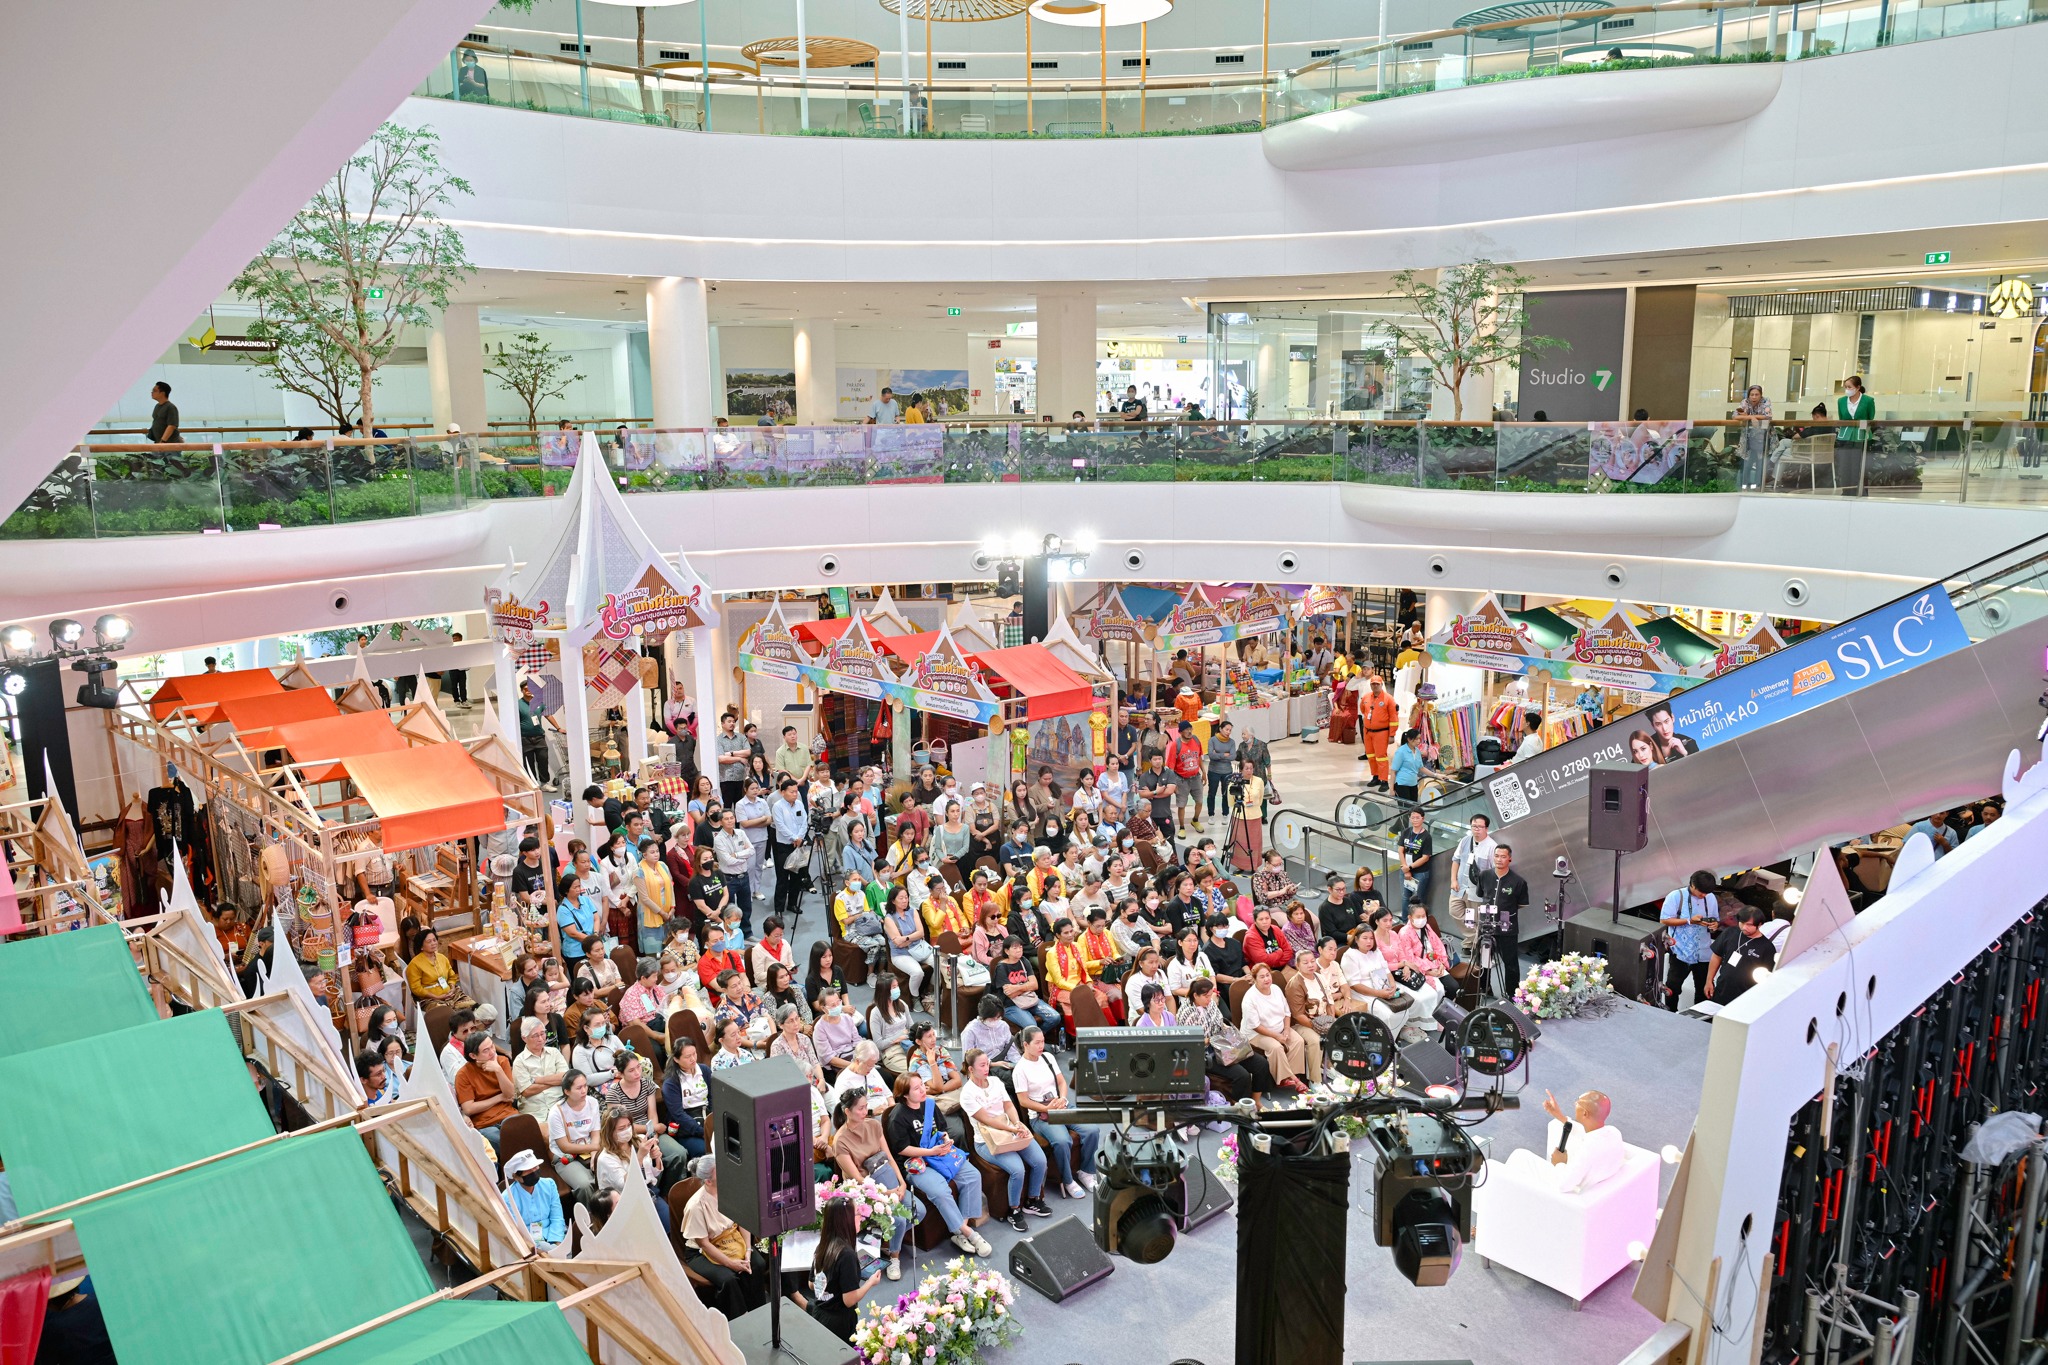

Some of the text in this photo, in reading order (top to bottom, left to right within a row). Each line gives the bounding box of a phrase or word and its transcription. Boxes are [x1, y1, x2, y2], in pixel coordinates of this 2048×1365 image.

[1529, 368, 1613, 392] Studio 7
[617, 588, 649, 600] มหกรรม
[1731, 644, 1759, 652] มหกรรม
[1837, 616, 1933, 680] SLC
[1802, 667, 1819, 677] PLUS
[1758, 678, 1790, 696] Ultherapy
[1764, 687, 1789, 700] PROGRAM
[1679, 700, 1723, 728] หน้าเล็ก
[1551, 743, 1624, 781] 0 2780 2104
[1286, 824, 1292, 839] 1
[1093, 1029, 1129, 1037] STROBE
